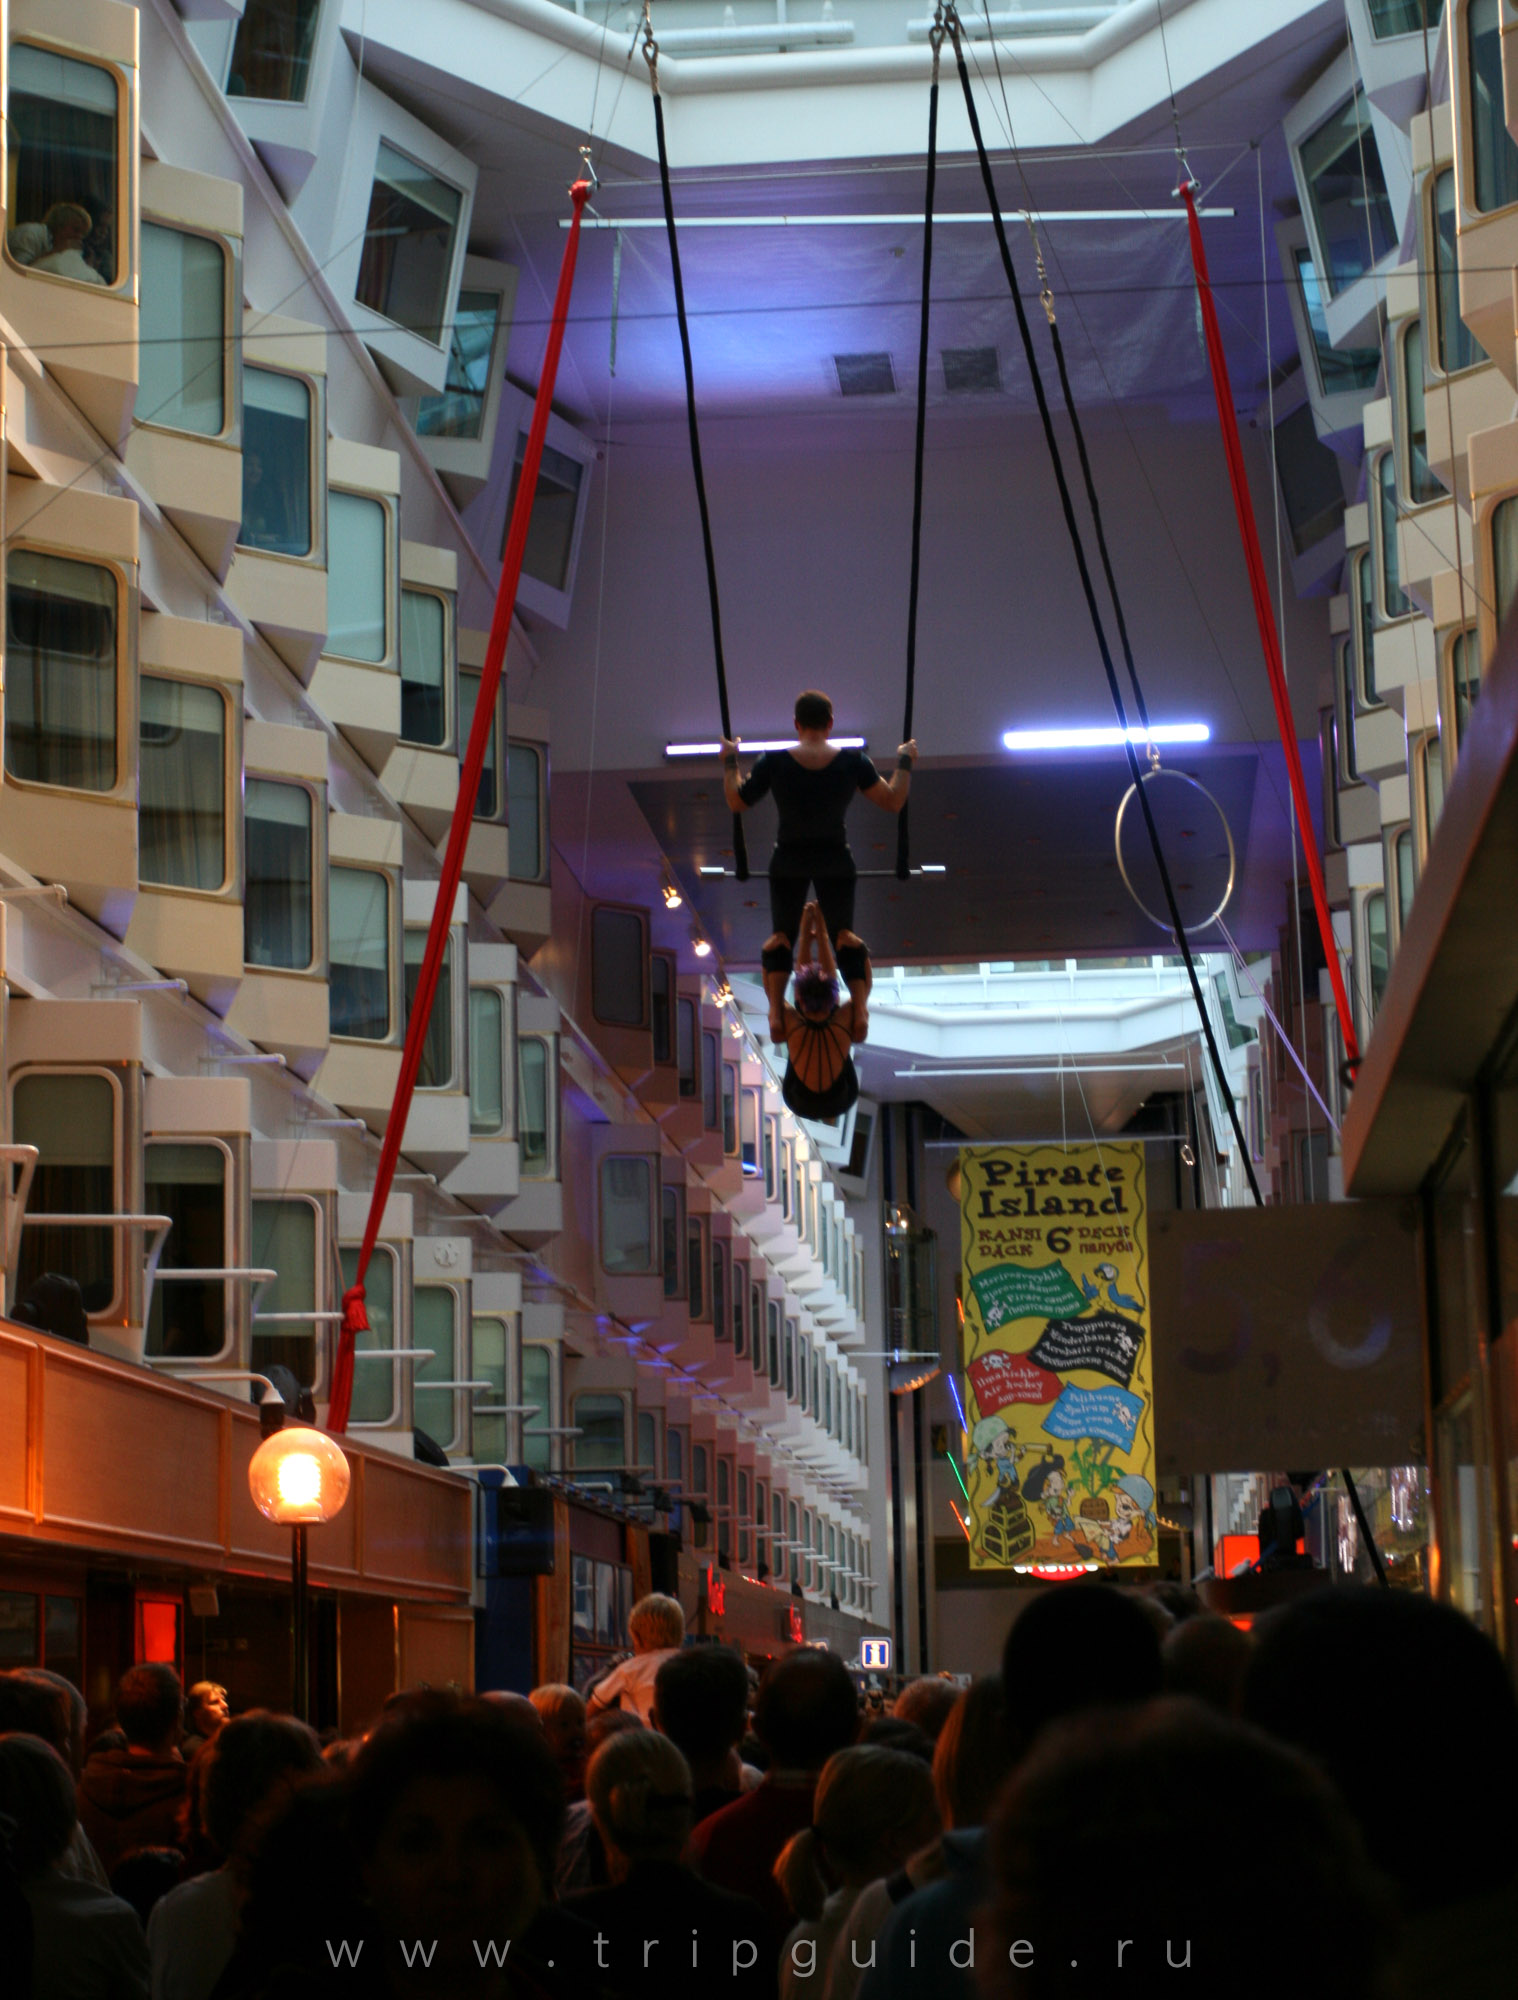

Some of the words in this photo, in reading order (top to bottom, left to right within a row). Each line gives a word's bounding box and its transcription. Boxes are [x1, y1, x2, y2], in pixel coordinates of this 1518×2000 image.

[978, 1160, 1125, 1188] Pirate
[978, 1186, 1128, 1218] Island
[978, 1226, 1042, 1242] KANSI
[1046, 1226, 1074, 1254] 6
[1078, 1225, 1130, 1239] DECK
[983, 1385, 1002, 1400] Air
[1005, 1378, 1043, 1390] hockey
